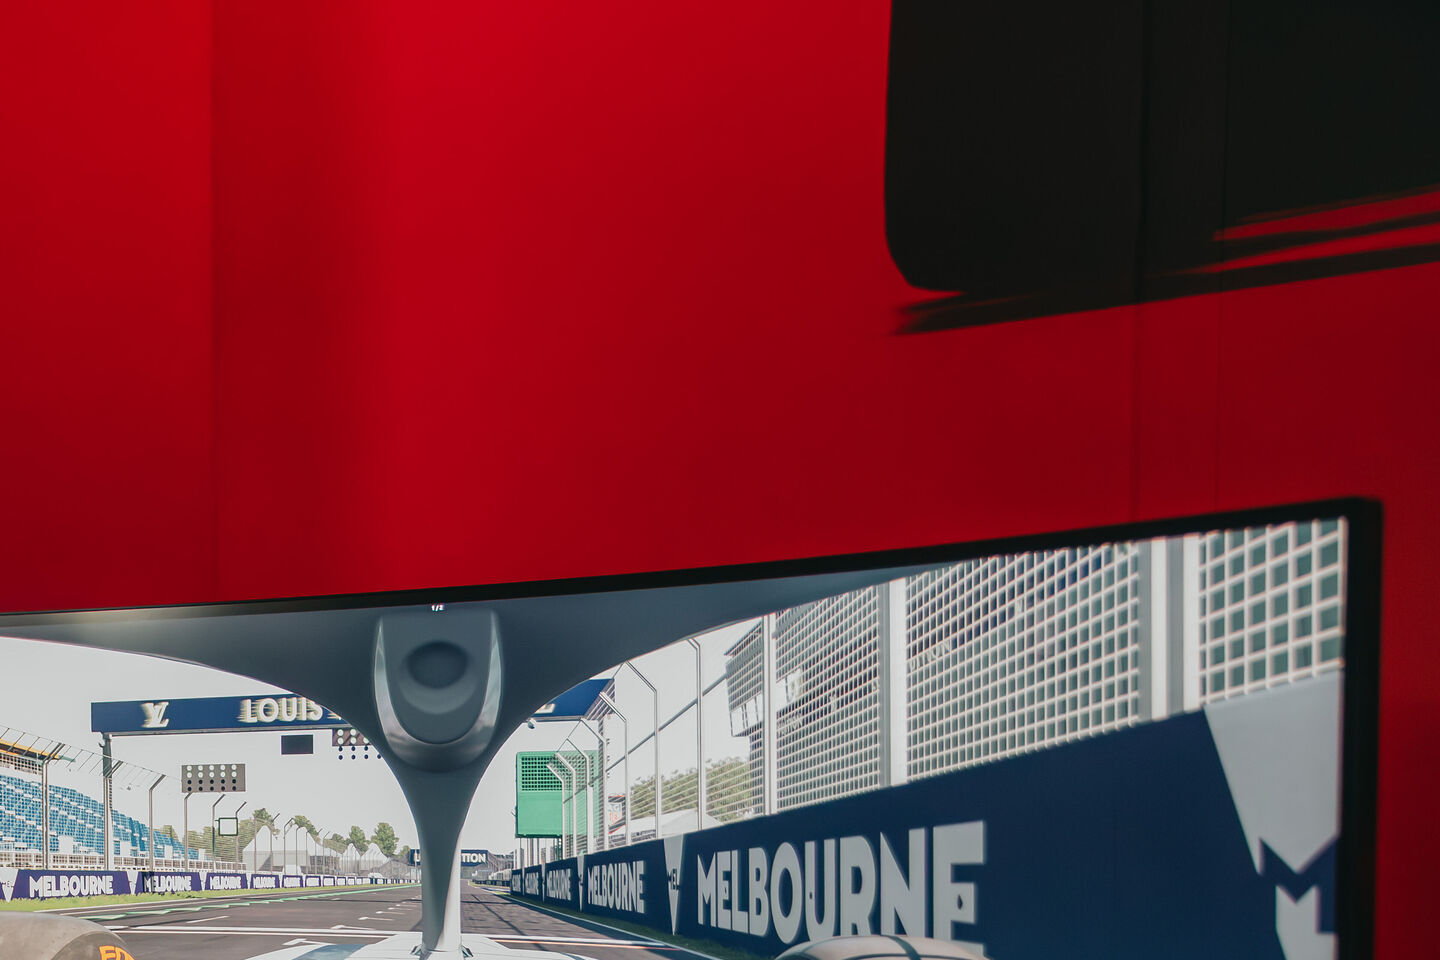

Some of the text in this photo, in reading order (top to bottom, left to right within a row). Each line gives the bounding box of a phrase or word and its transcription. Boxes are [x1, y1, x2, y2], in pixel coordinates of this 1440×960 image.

[243, 697, 324, 723] LOUIS
[461, 853, 486, 864] TTON
[28, 875, 114, 898] MELBOURNE
[587, 860, 645, 914] MELBOURNE
[697, 820, 985, 958] MELBOURNE
